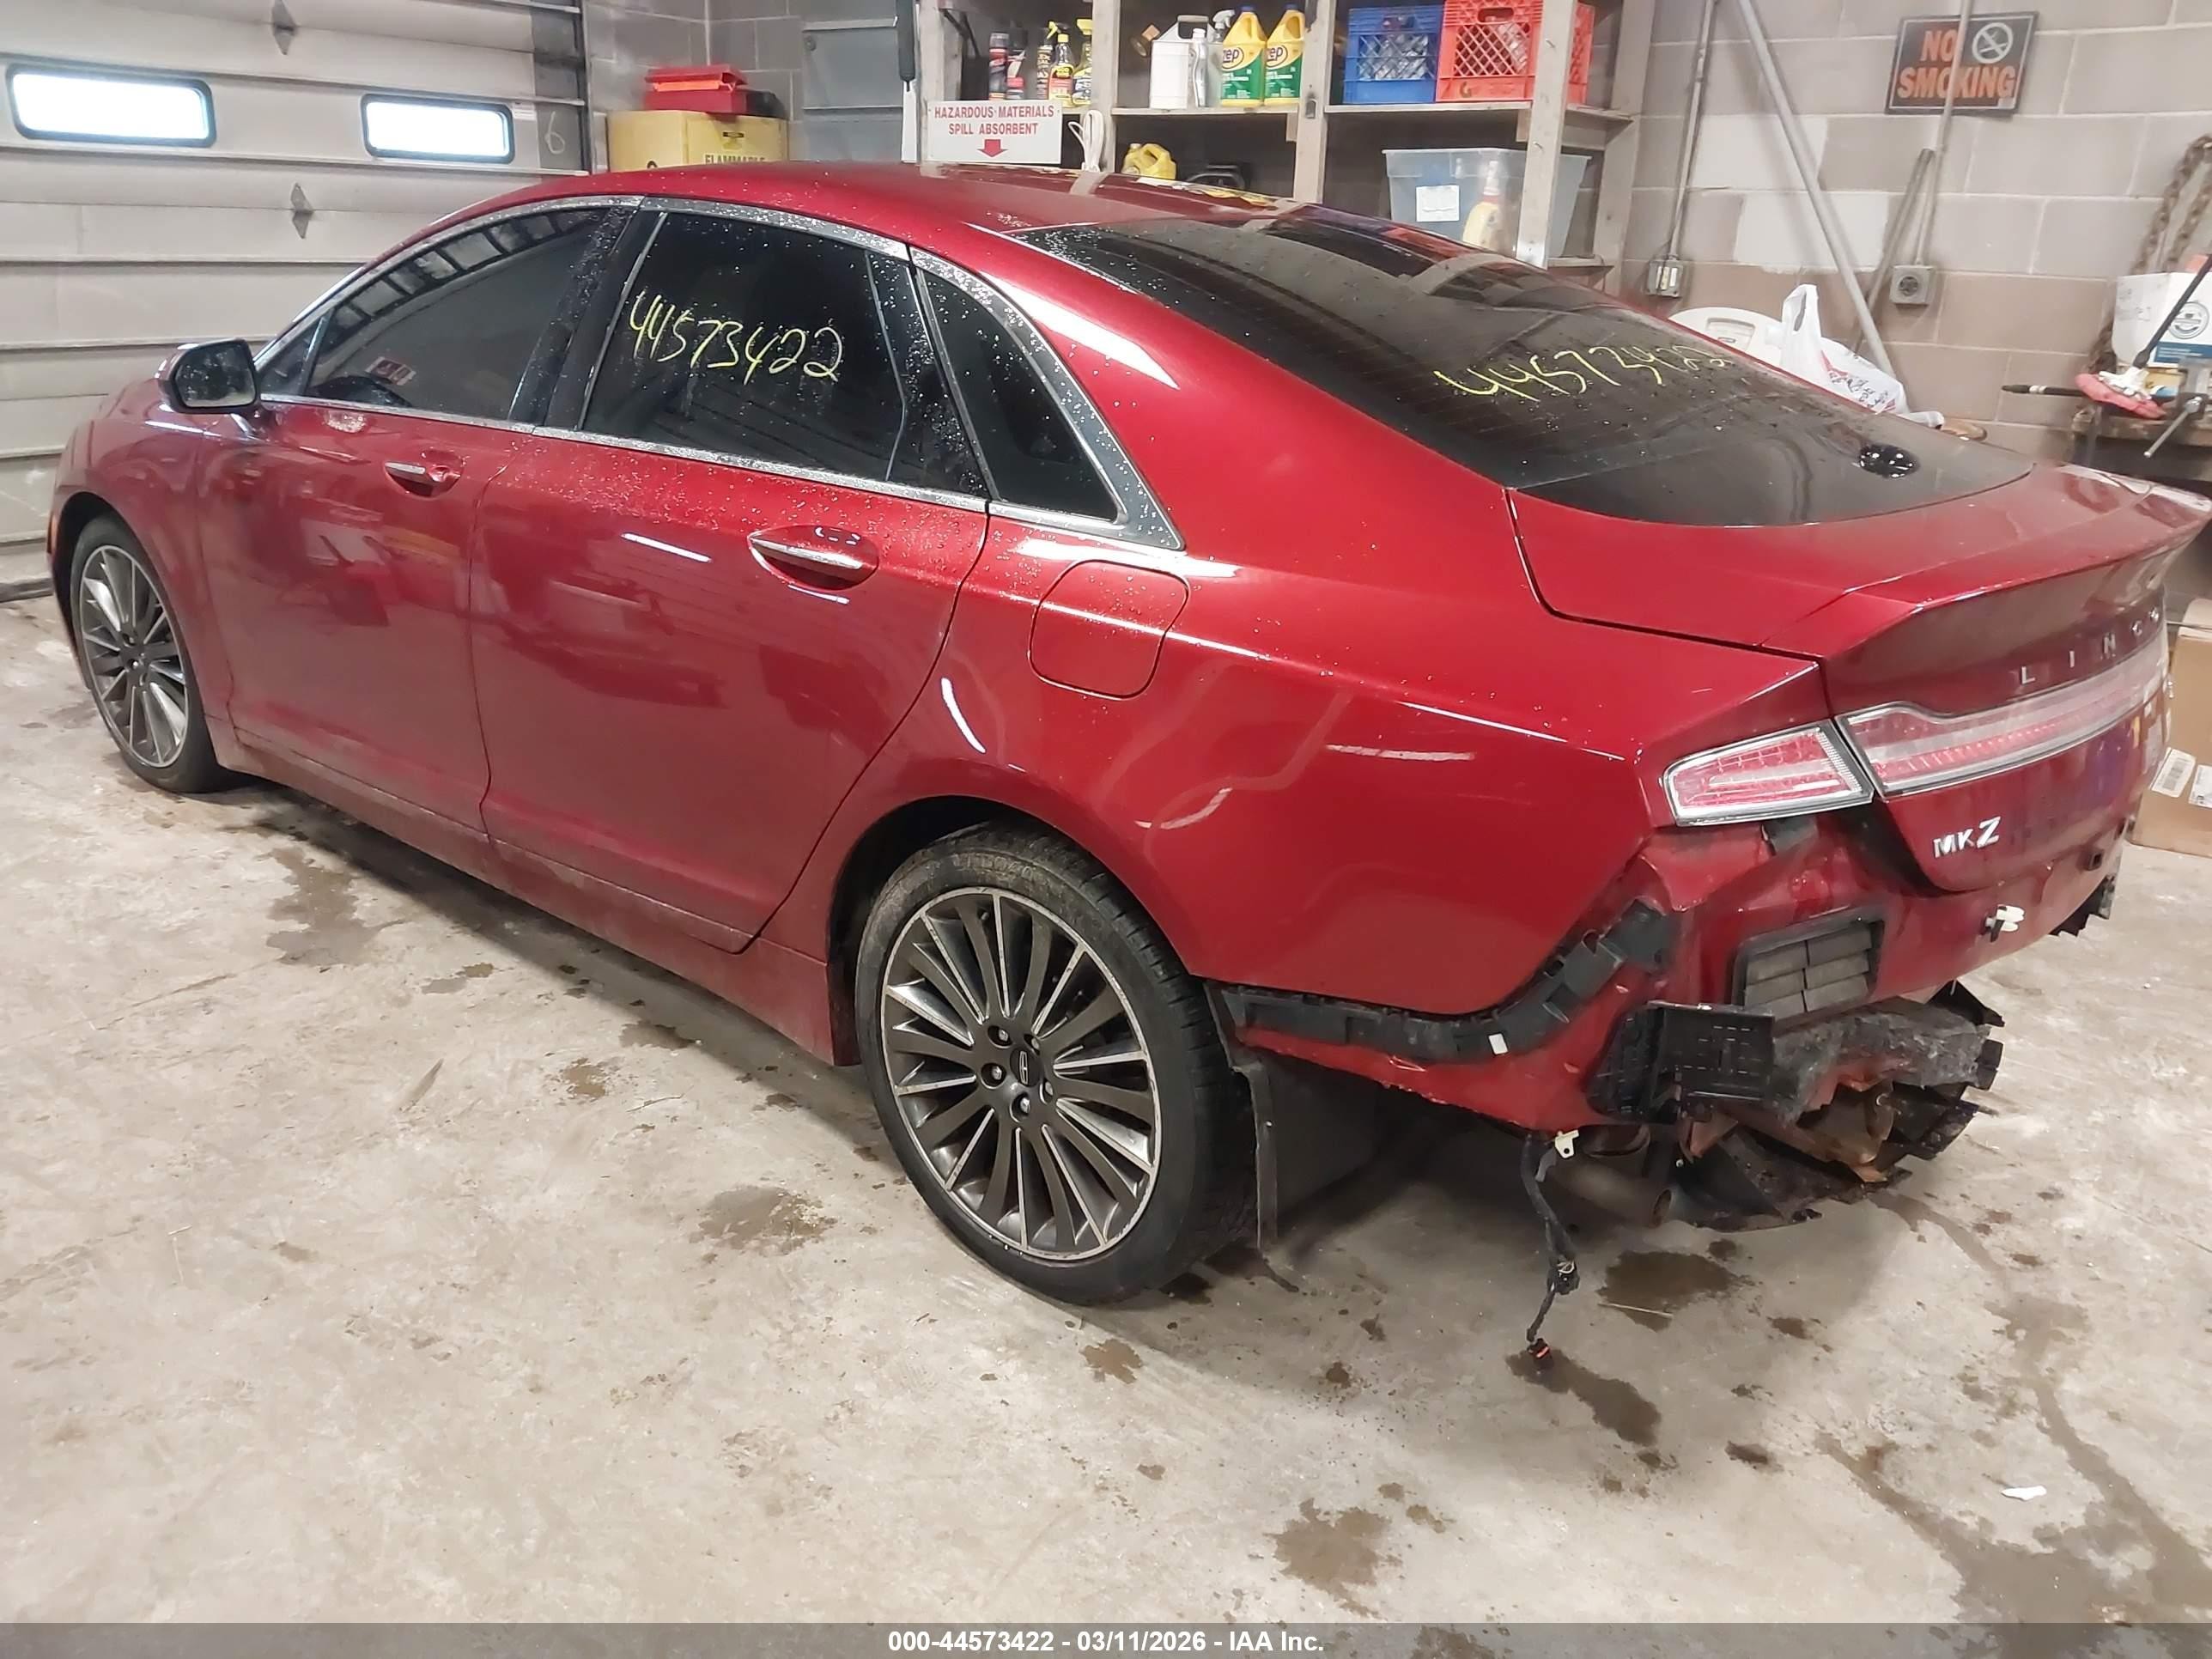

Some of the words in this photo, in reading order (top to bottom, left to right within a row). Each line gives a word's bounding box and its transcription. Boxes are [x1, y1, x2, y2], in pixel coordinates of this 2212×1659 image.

[1920, 28, 1959, 62] NO
[1897, 65, 2016, 99] SMOKING
[934, 106, 994, 118] HAZARDOUS
[998, 105, 1054, 118] MATERIALS
[948, 123, 974, 135] SPILL
[979, 122, 1038, 135] ABSORBENT
[544, 111, 566, 154] 6
[705, 155, 766, 165] FLAMM
[629, 290, 844, 386] 44573422
[1933, 816, 2002, 859] MKZ
